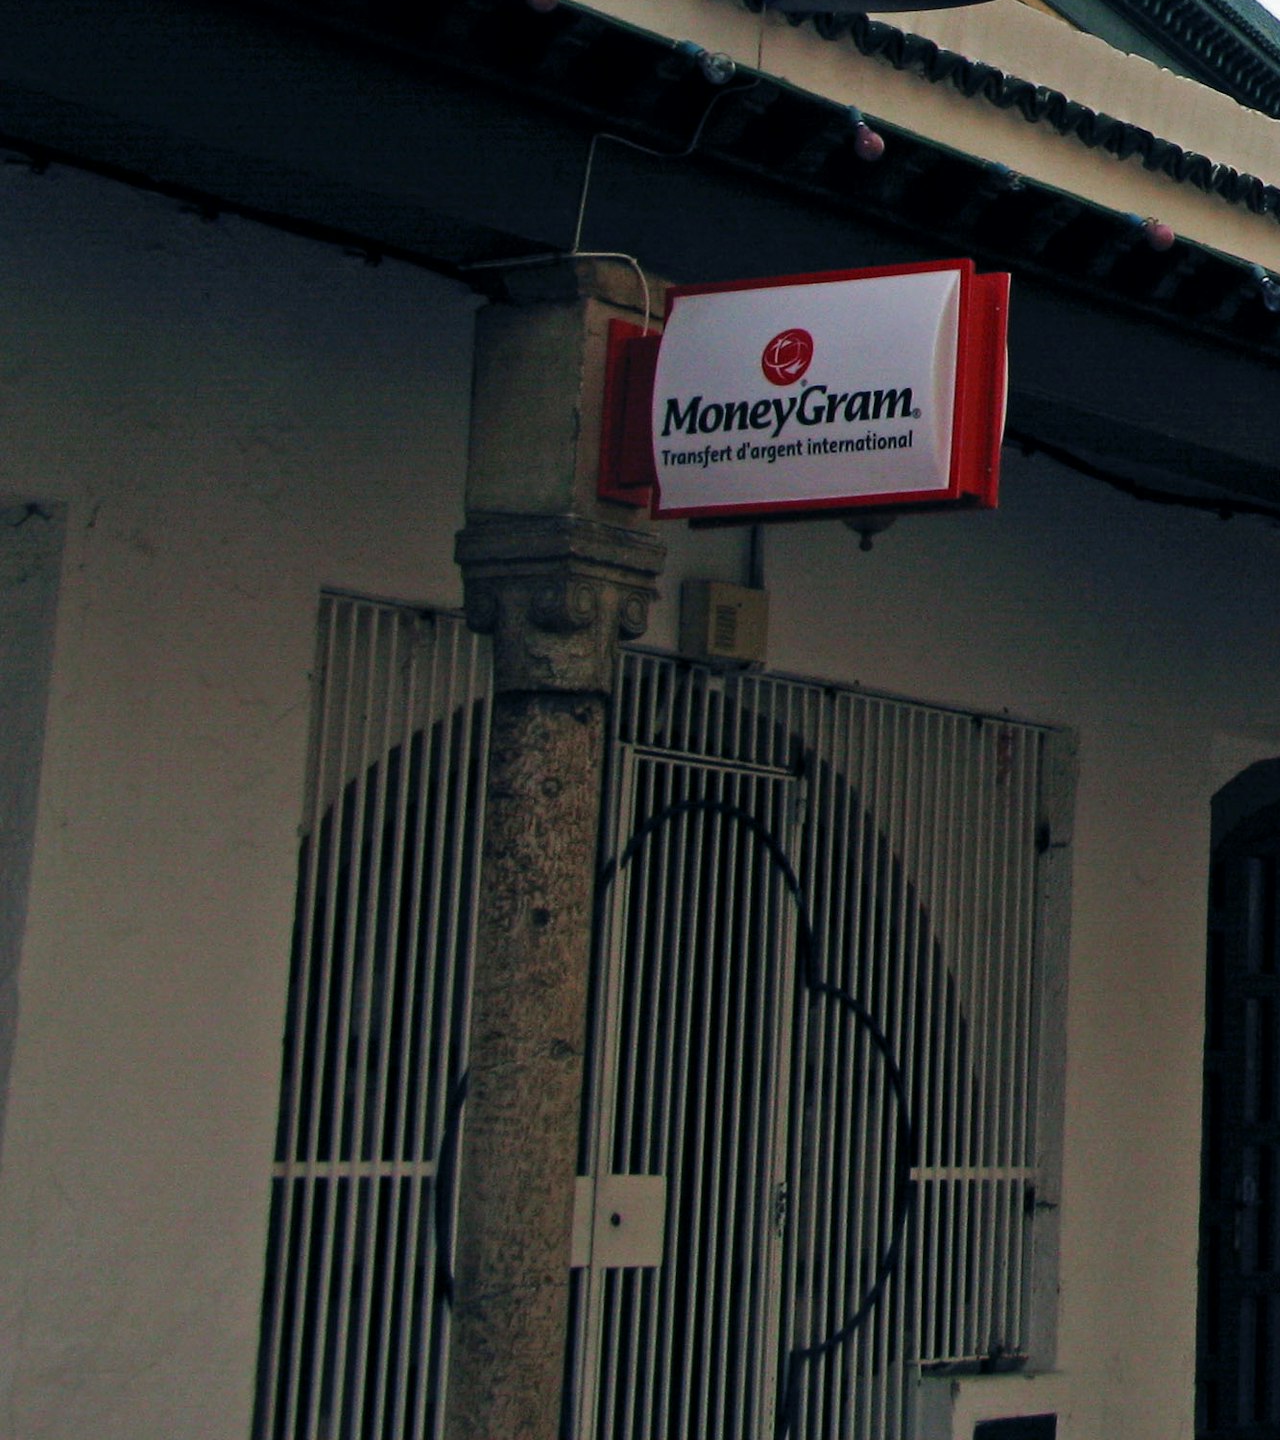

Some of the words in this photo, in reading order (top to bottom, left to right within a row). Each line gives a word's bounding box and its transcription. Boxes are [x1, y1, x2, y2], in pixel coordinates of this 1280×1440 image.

[660, 383, 913, 439] MoneyGram
[661, 440, 733, 469] Transfert
[736, 436, 803, 463] d'argent
[806, 430, 913, 456] international
